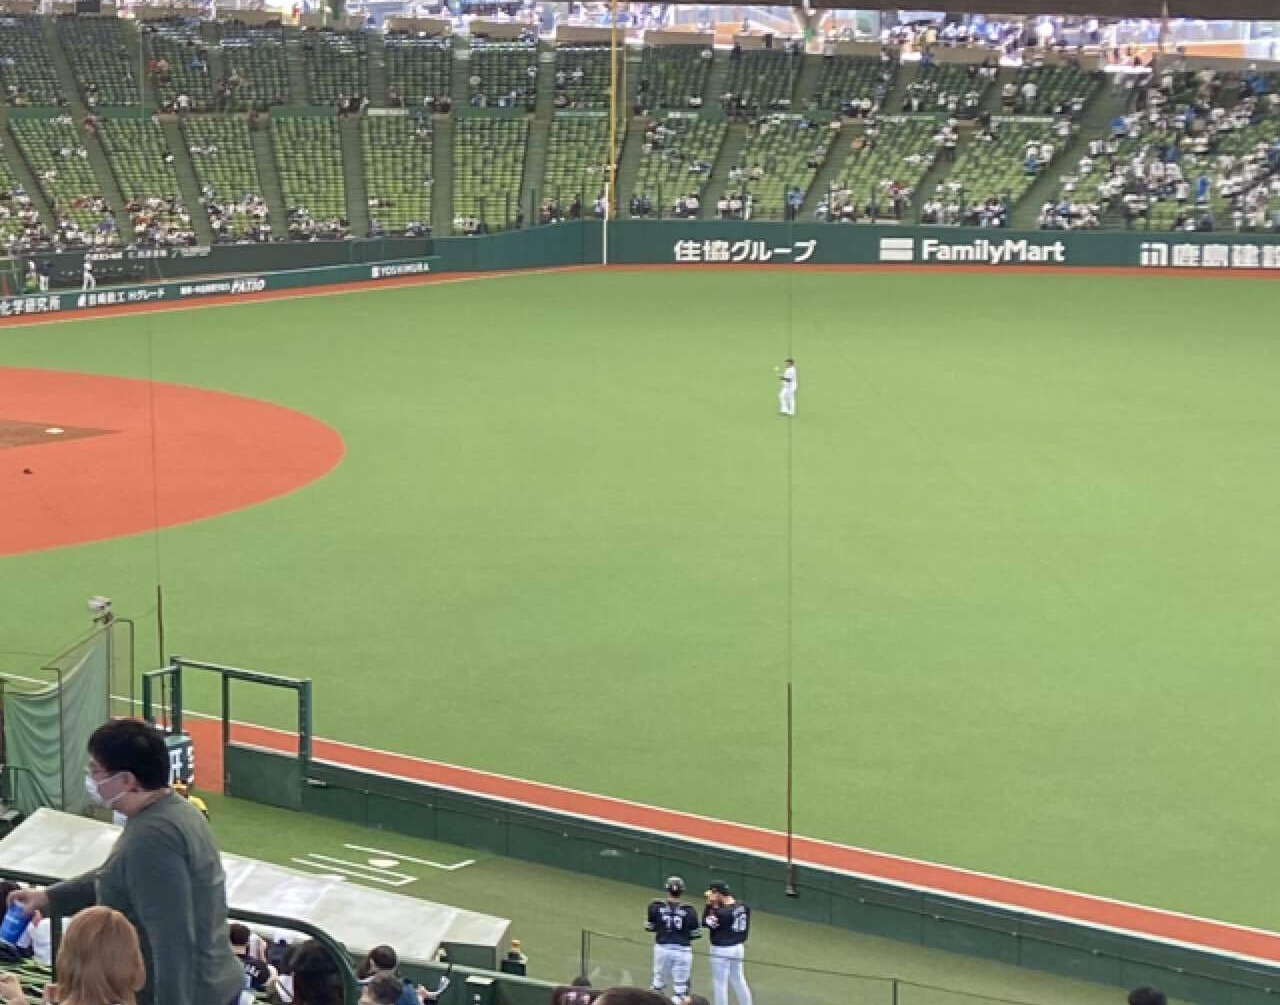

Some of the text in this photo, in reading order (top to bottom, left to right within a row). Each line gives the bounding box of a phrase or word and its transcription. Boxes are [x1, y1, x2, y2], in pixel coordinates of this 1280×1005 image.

[674, 239, 817, 262] 住協グループ
[922, 239, 1066, 265] FamilyMart
